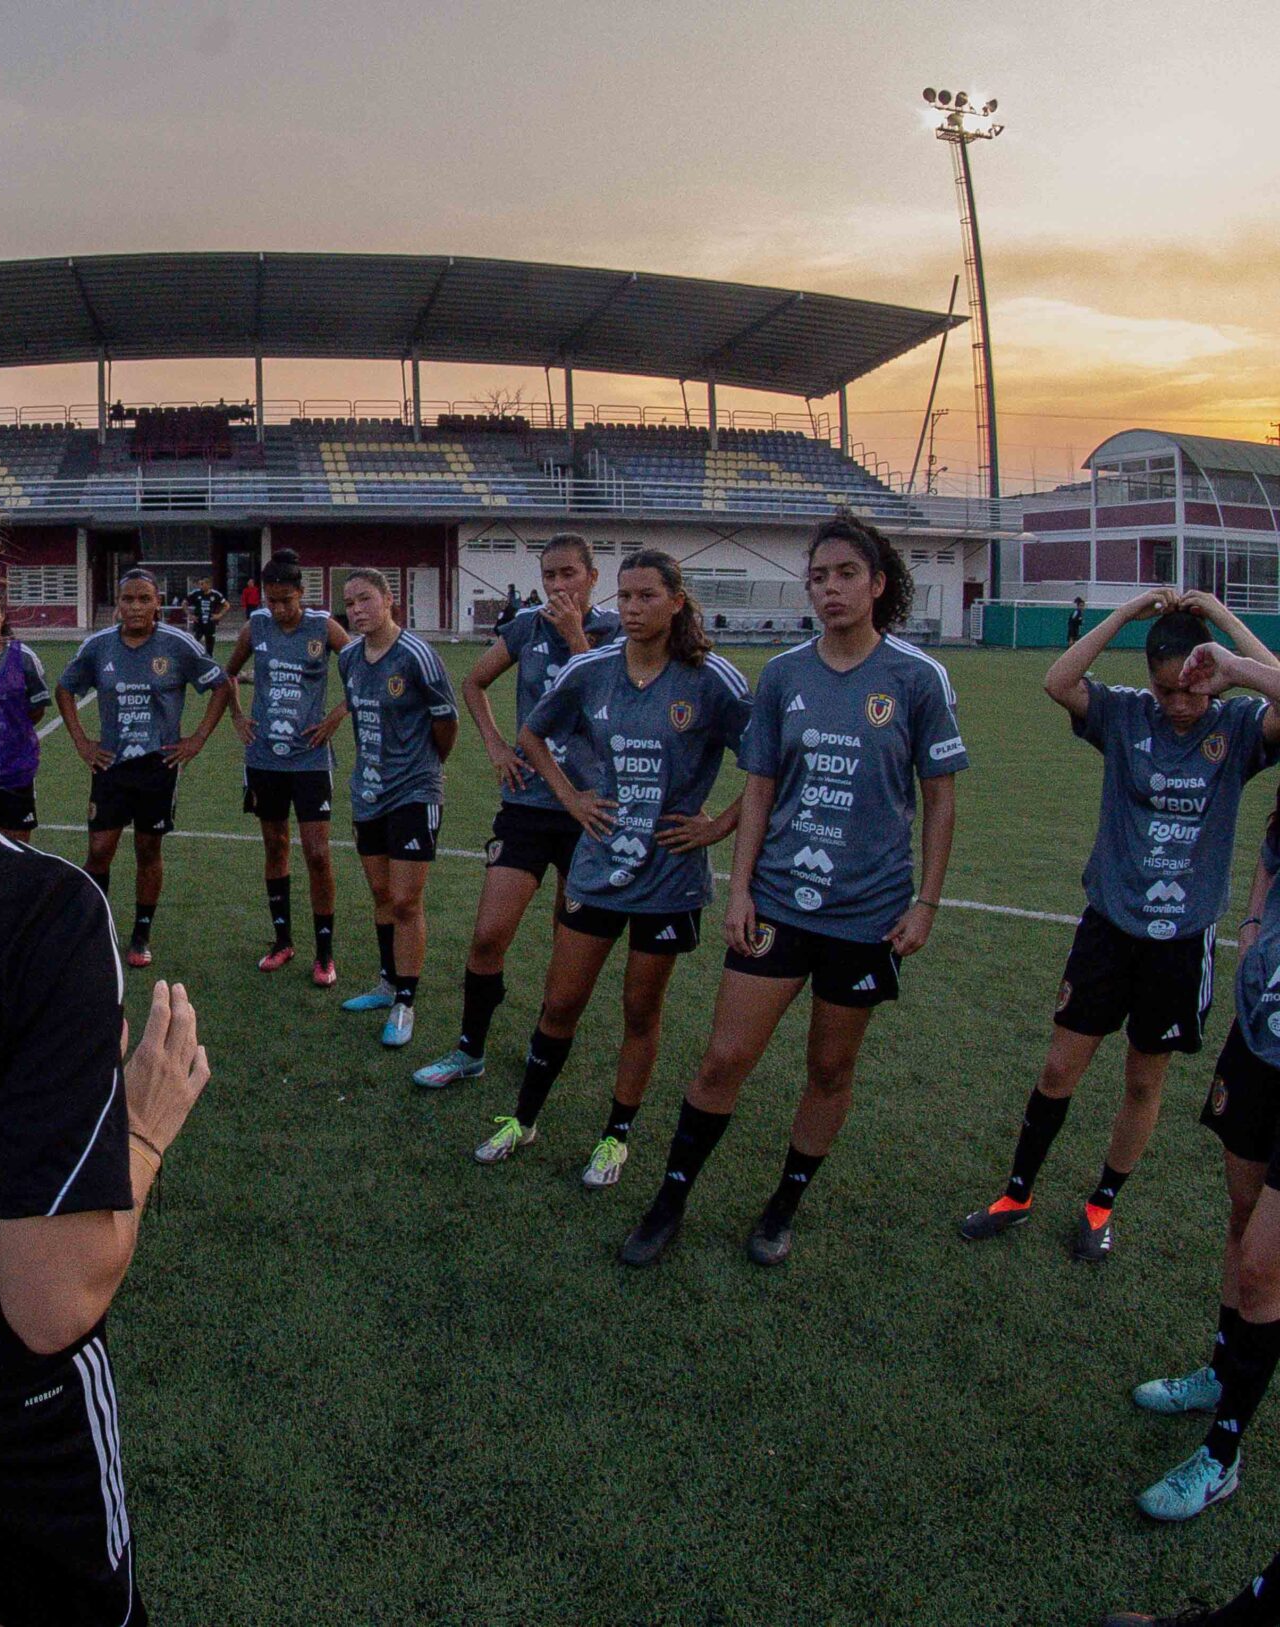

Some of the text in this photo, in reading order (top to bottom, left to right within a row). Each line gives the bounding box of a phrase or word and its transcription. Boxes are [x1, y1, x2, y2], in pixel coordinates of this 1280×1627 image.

[279, 672, 302, 683] BDV
[127, 695, 151, 705] BDV
[269, 687, 302, 700] Forum
[118, 712, 151, 724] Forum
[626, 739, 662, 750] PDVSA
[821, 732, 862, 748] PDVSA
[626, 757, 662, 773] BDV
[817, 754, 859, 776] BDV
[1166, 777, 1207, 789] PDVSA
[617, 784, 662, 803] orum
[1167, 798, 1207, 813] BDV
[790, 869, 832, 887] movilnet
[1143, 904, 1186, 914] movilnet
